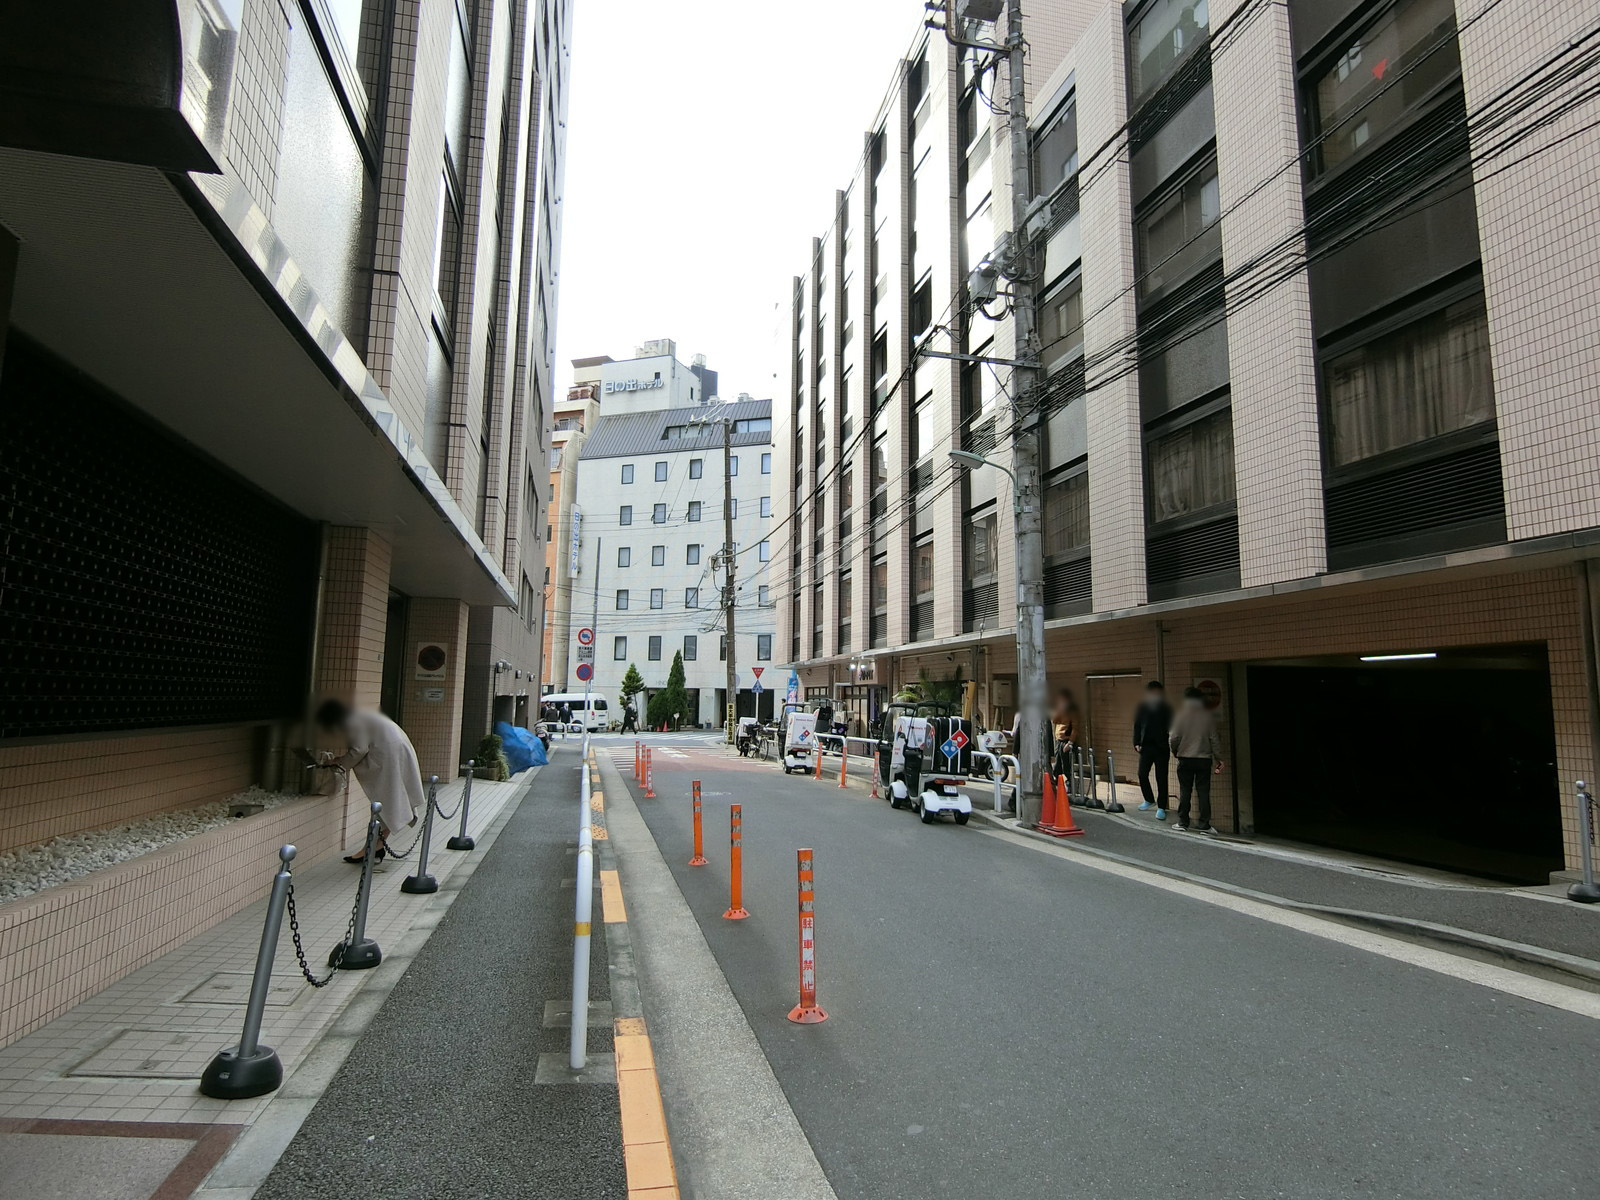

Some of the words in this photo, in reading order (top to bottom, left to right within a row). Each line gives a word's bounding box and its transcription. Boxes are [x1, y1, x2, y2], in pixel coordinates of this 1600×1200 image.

[605, 379, 664, 394] 日の出ホテル
[803, 919, 813, 990] 駐車禁止
